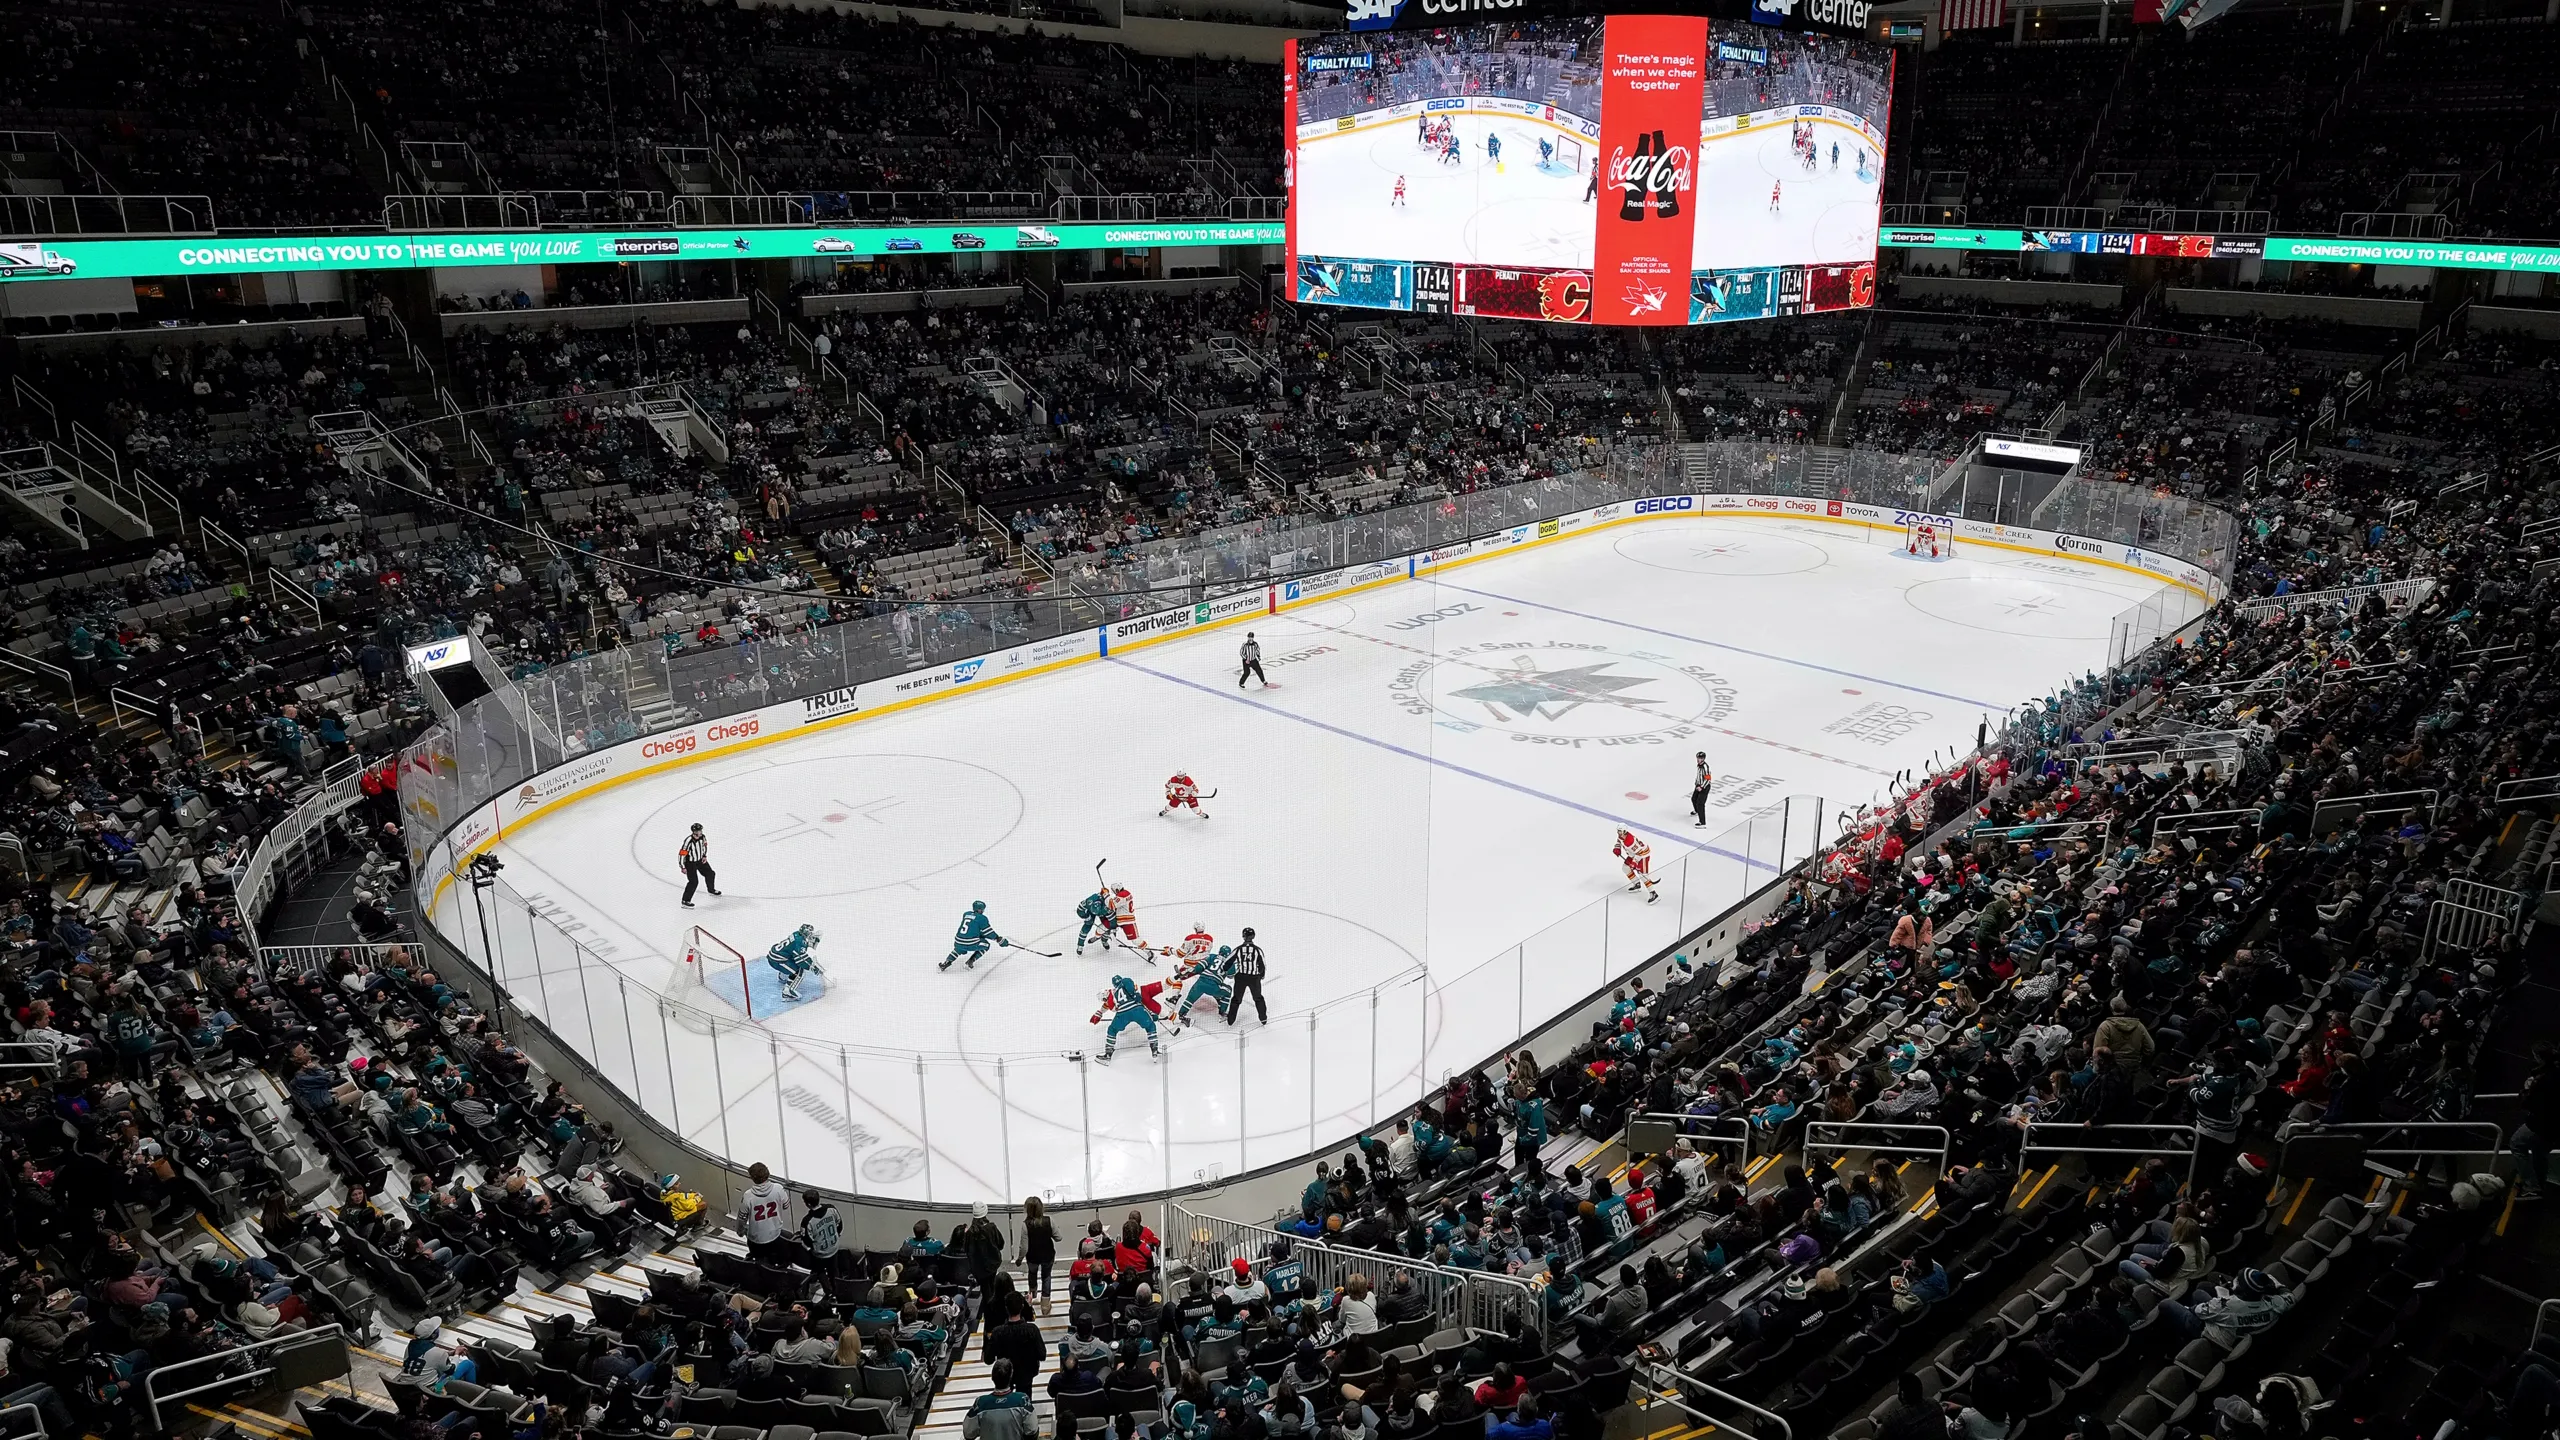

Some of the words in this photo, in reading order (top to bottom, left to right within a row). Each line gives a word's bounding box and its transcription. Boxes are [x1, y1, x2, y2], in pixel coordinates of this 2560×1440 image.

[1811, 0, 1873, 29] center
[1311, 55, 1349, 69] PENALTY
[1350, 53, 1369, 68] KILL
[1617, 54, 1659, 65] There's
[1662, 55, 1695, 66] magic
[1721, 44, 1750, 61] PENALTY
[1750, 49, 1765, 64] KILL
[1612, 68, 1645, 77] when
[1648, 69, 1665, 77] we
[1668, 68, 1697, 78] cheer
[1630, 80, 1680, 91] together
[1427, 99, 1464, 110] GEICO
[1800, 106, 1822, 115] GEICO
[1607, 146, 1691, 192] Coca-Cola
[1105, 229, 1172, 242] CONNECTING
[1173, 229, 1193, 240] YOU
[1194, 229, 1208, 240] TO
[1210, 228, 1227, 240] THE
[1228, 227, 1255, 239] GAME
[1256, 228, 1272, 243] YOU
[1883, 233, 1935, 243] enterprise
[2081, 235, 2087, 251] 1
[2102, 234, 2131, 246] 17:14
[179, 245, 323, 266] CONNECTING
[329, 244, 370, 262] YOU
[377, 244, 402, 259] TO
[405, 243, 446, 259] THE
[449, 241, 505, 258] GAME
[509, 241, 541, 263] YOU
[545, 239, 583, 256] LOVE
[600, 239, 678, 257] enterprise
[682, 242, 705, 251] Official
[706, 240, 729, 250] Partner
[2139, 237, 2147, 254] 1
[2291, 244, 2381, 259] CONNECTING
[2384, 247, 2415, 260] YOU
[2417, 248, 2434, 261] TO
[2437, 248, 2463, 262] THE
[2465, 252, 2506, 264] GAME
[2510, 252, 2535, 269] YOU
[1393, 266, 1401, 298] 1
[1416, 267, 1449, 290] 17:14
[1495, 271, 1520, 281] PENALTY
[1781, 271, 1802, 293] 17:14
[1457, 269, 1466, 302] 1
[1766, 272, 1772, 305] 1
[1806, 270, 1813, 301] 1
[1429, 291, 1449, 301] Period
[1634, 496, 1693, 514] GEICO
[1747, 498, 1778, 510] Chegg
[1784, 500, 1817, 513] Chegg
[1845, 506, 1880, 518] TOYOTA
[1540, 524, 1557, 533] DGDG
[1566, 518, 1580, 526] HAPPY
[1512, 529, 1525, 541] SAP
[1964, 523, 1993, 534] CACHE
[2005, 530, 2033, 540] CREEK
[1453, 546, 1472, 557] LIGHT
[2055, 534, 2103, 554] Corona
[2144, 556, 2160, 565] KAISER
[1301, 574, 1323, 585] PACIFIC
[1323, 570, 1343, 581] OFFICE
[1384, 564, 1401, 576] Bank
[1301, 579, 1339, 593] AUTOMATION
[1197, 595, 1261, 618] enterprise
[1117, 609, 1191, 638] smartwater
[1032, 641, 1058, 654] Northern
[1059, 636, 1086, 648] California
[1488, 640, 1534, 651] San
[1549, 640, 1608, 652] Jose
[423, 646, 449, 663] NSI
[1033, 652, 1052, 661] Honda
[1052, 647, 1074, 658] Dealers
[954, 664, 979, 682] SAP
[896, 681, 912, 692] THE
[913, 677, 933, 688] BEST
[934, 673, 951, 683] RUN
[802, 686, 857, 712] TRULY
[807, 709, 827, 718] HARD
[828, 702, 855, 714] SELTZER
[707, 718, 760, 741] Chegg
[1835, 705, 1908, 738] CREEK
[1862, 711, 1934, 746] CACHE
[669, 731, 684, 739] Learn
[642, 735, 696, 758] Chegg
[538, 766, 588, 791] CHUKCHANSI
[588, 756, 612, 769] GOLD
[545, 781, 570, 796] RESORT
[580, 767, 606, 781] CASINO
[1711, 775, 1785, 808] Western
[1243, 951, 1253, 962] 74
[1118, 989, 1127, 1001] 4
[117, 1020, 144, 1041] 62
[2199, 1088, 2213, 1101] 88
[196, 1155, 210, 1169] 19
[754, 1201, 778, 1221] 22
[1611, 1210, 1633, 1236] 88
[549, 1226, 561, 1238] 65
[819, 1224, 838, 1251] 39
[1275, 1264, 1300, 1280] MARLEAU
[1281, 1275, 1300, 1292] 12
[1184, 1304, 1213, 1317] THORNTON
